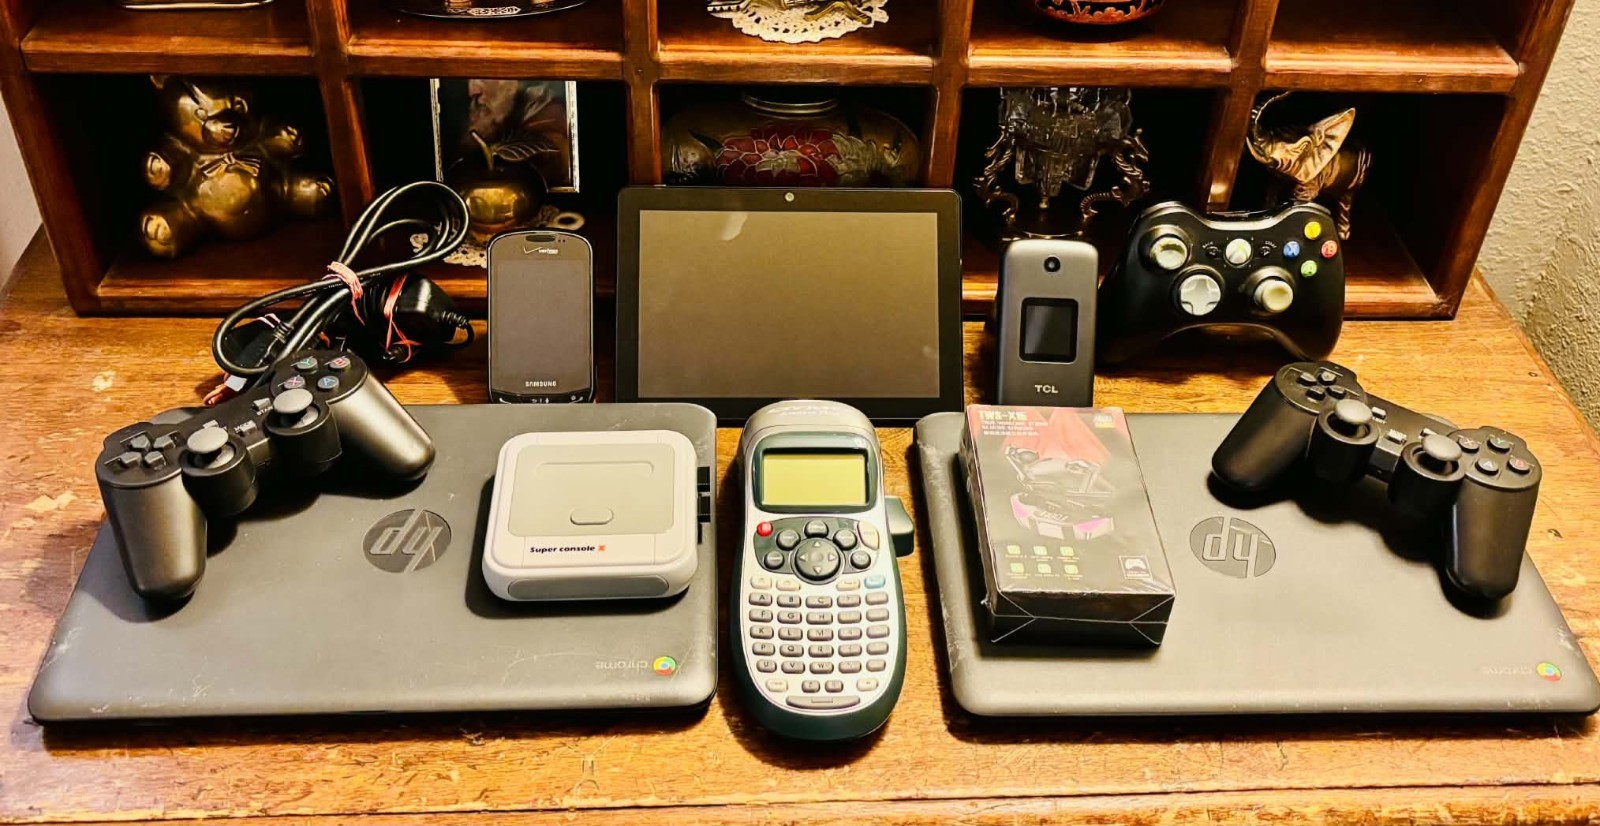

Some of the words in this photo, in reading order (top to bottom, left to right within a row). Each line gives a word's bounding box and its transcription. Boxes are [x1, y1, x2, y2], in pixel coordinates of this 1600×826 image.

[322, 376, 336, 386] A
[1034, 384, 1059, 394] TCL
[366, 509, 447, 573] hp
[529, 546, 558, 554] Super
[1198, 516, 1265, 578] hp
